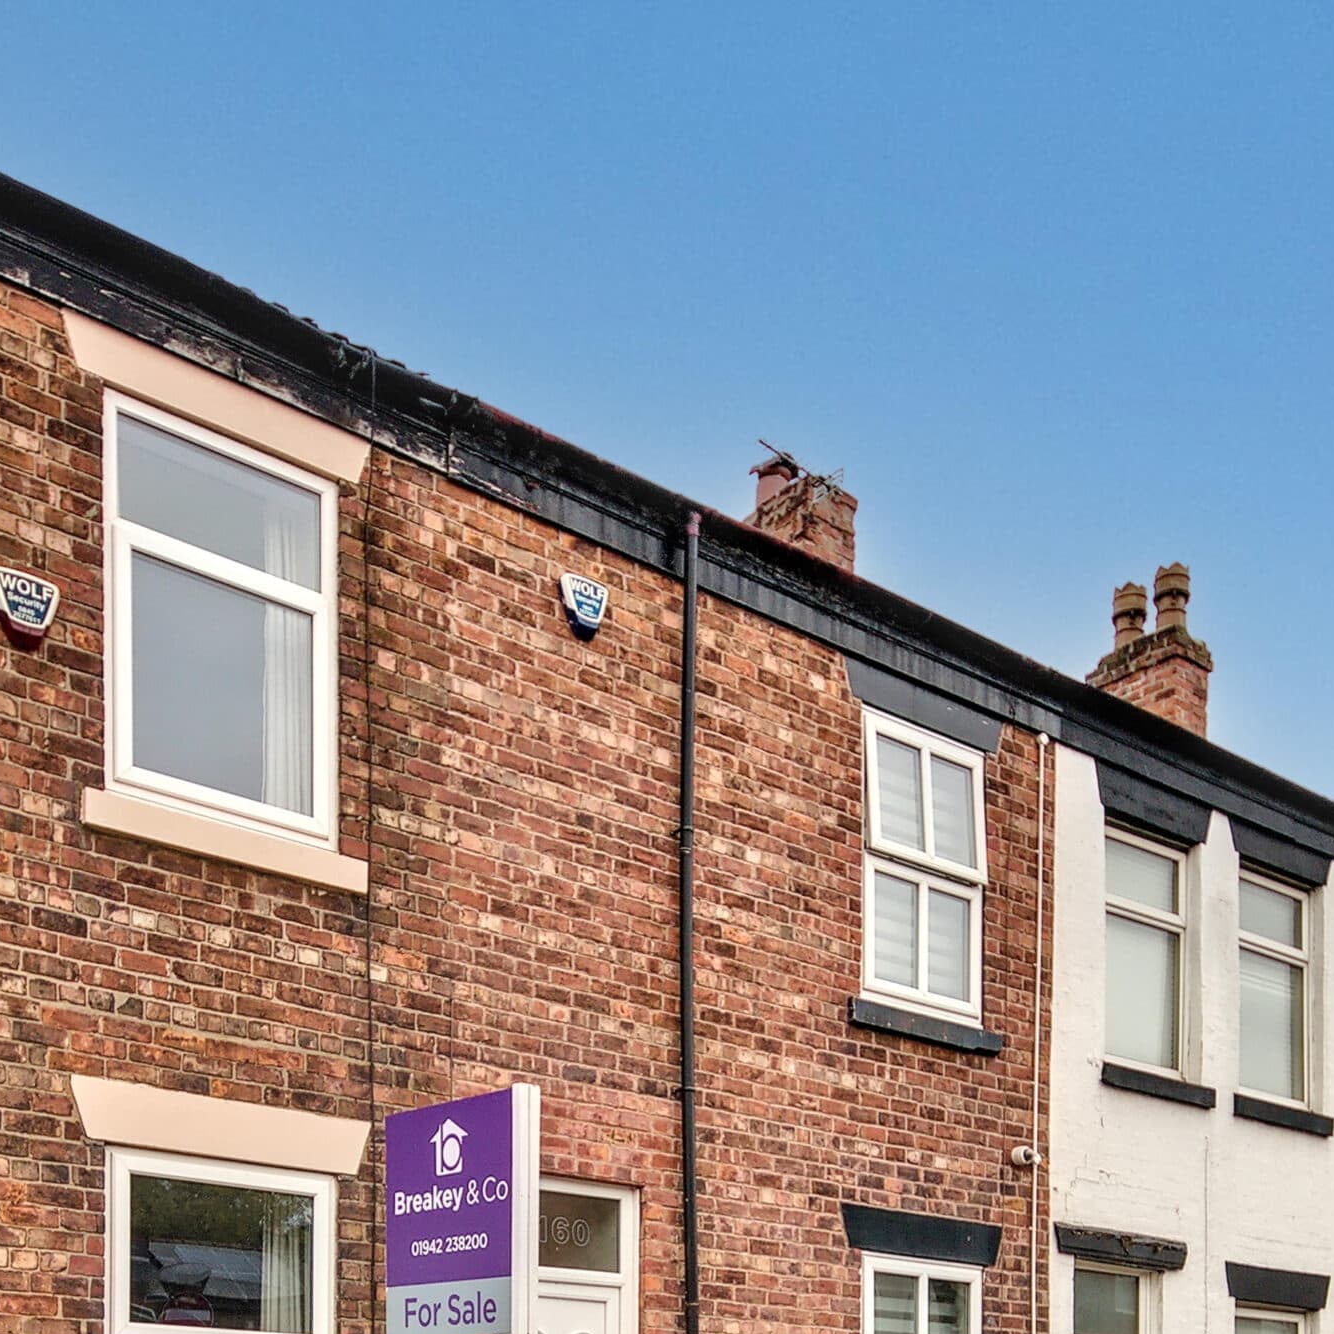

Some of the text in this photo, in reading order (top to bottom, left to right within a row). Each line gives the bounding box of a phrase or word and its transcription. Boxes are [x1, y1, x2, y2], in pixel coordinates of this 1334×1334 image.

[0, 573, 53, 601] WOLF
[571, 578, 605, 600] WOLF
[394, 1176, 509, 1216] Breakey & Co
[411, 1232, 488, 1257] 01942 238200
[539, 1215, 590, 1247] 160
[404, 1291, 497, 1328] For Sale
